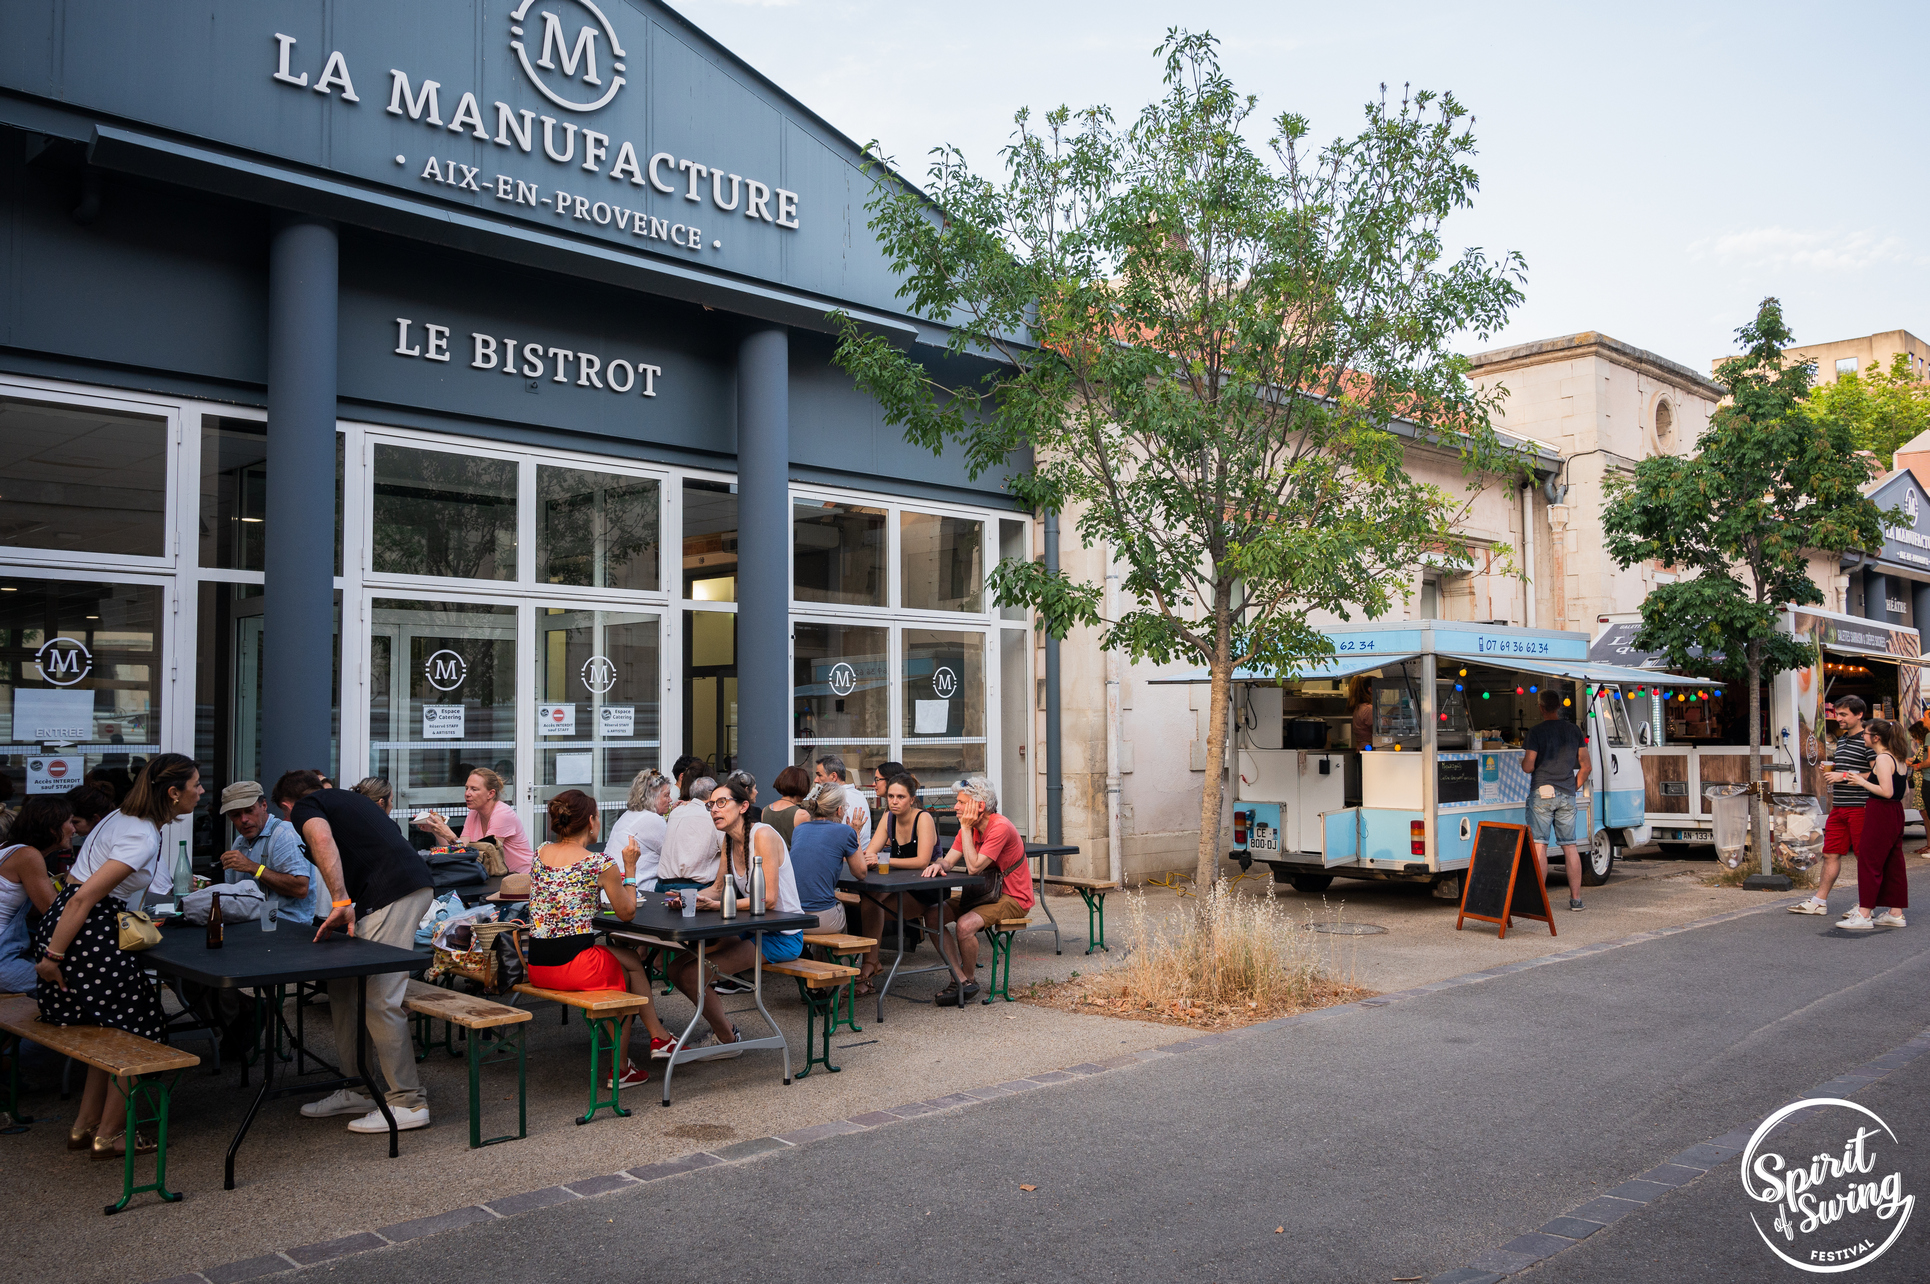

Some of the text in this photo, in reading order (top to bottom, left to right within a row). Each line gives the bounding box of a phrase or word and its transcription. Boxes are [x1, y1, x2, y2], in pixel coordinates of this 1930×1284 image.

[537, 10, 602, 85] M
[273, 32, 799, 229] LA MANUFACTURE
[420, 155, 702, 249] AIX-EN-PROVENCE
[395, 317, 662, 397] LE BISTROT
[1885, 597, 1907, 614] HÉÂTRE
[1339, 640, 1375, 650] 62 34
[1485, 639, 1549, 654] 07 69 36 62 34
[47, 649, 79, 673] M
[434, 659, 458, 680] M
[589, 665, 609, 683] M
[835, 670, 851, 687] M
[938, 674, 952, 690] M
[441, 708, 461, 716] Espace
[35, 726, 84, 737] ENTRÉE
